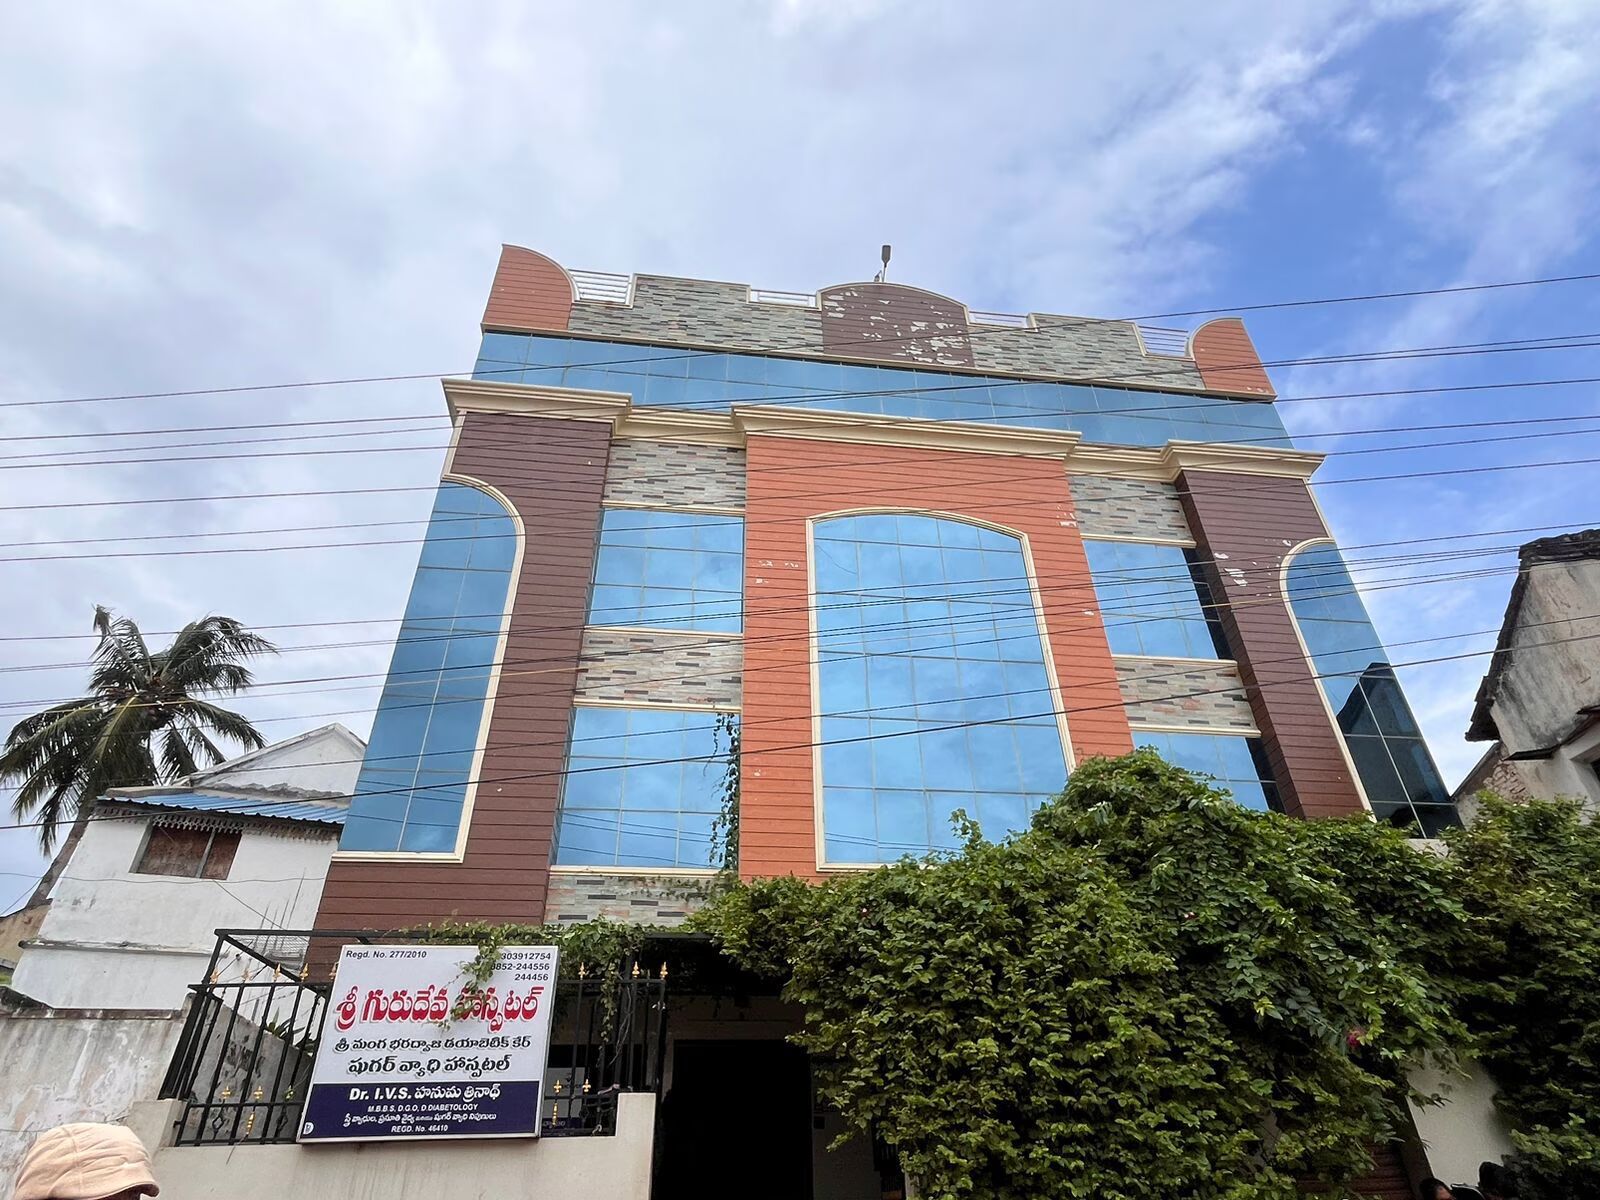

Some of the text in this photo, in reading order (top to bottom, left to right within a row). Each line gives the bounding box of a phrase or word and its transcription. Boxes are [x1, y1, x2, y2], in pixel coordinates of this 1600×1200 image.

[346, 950, 427, 960] Regd. No. 277/2010
[514, 973, 549, 981] 244456
[336, 985, 358, 1030] శ్రీ
[362, 984, 448, 1021] గురుదేవ
[352, 1038, 387, 1050] మంగ
[389, 1038, 442, 1052] భరద్వాజ
[348, 1054, 513, 1078] షుగర్ వ్యాధి హాస్పటల్
[349, 1083, 501, 1103] Dr. I.V.S. హనుమ త్రినాథ్
